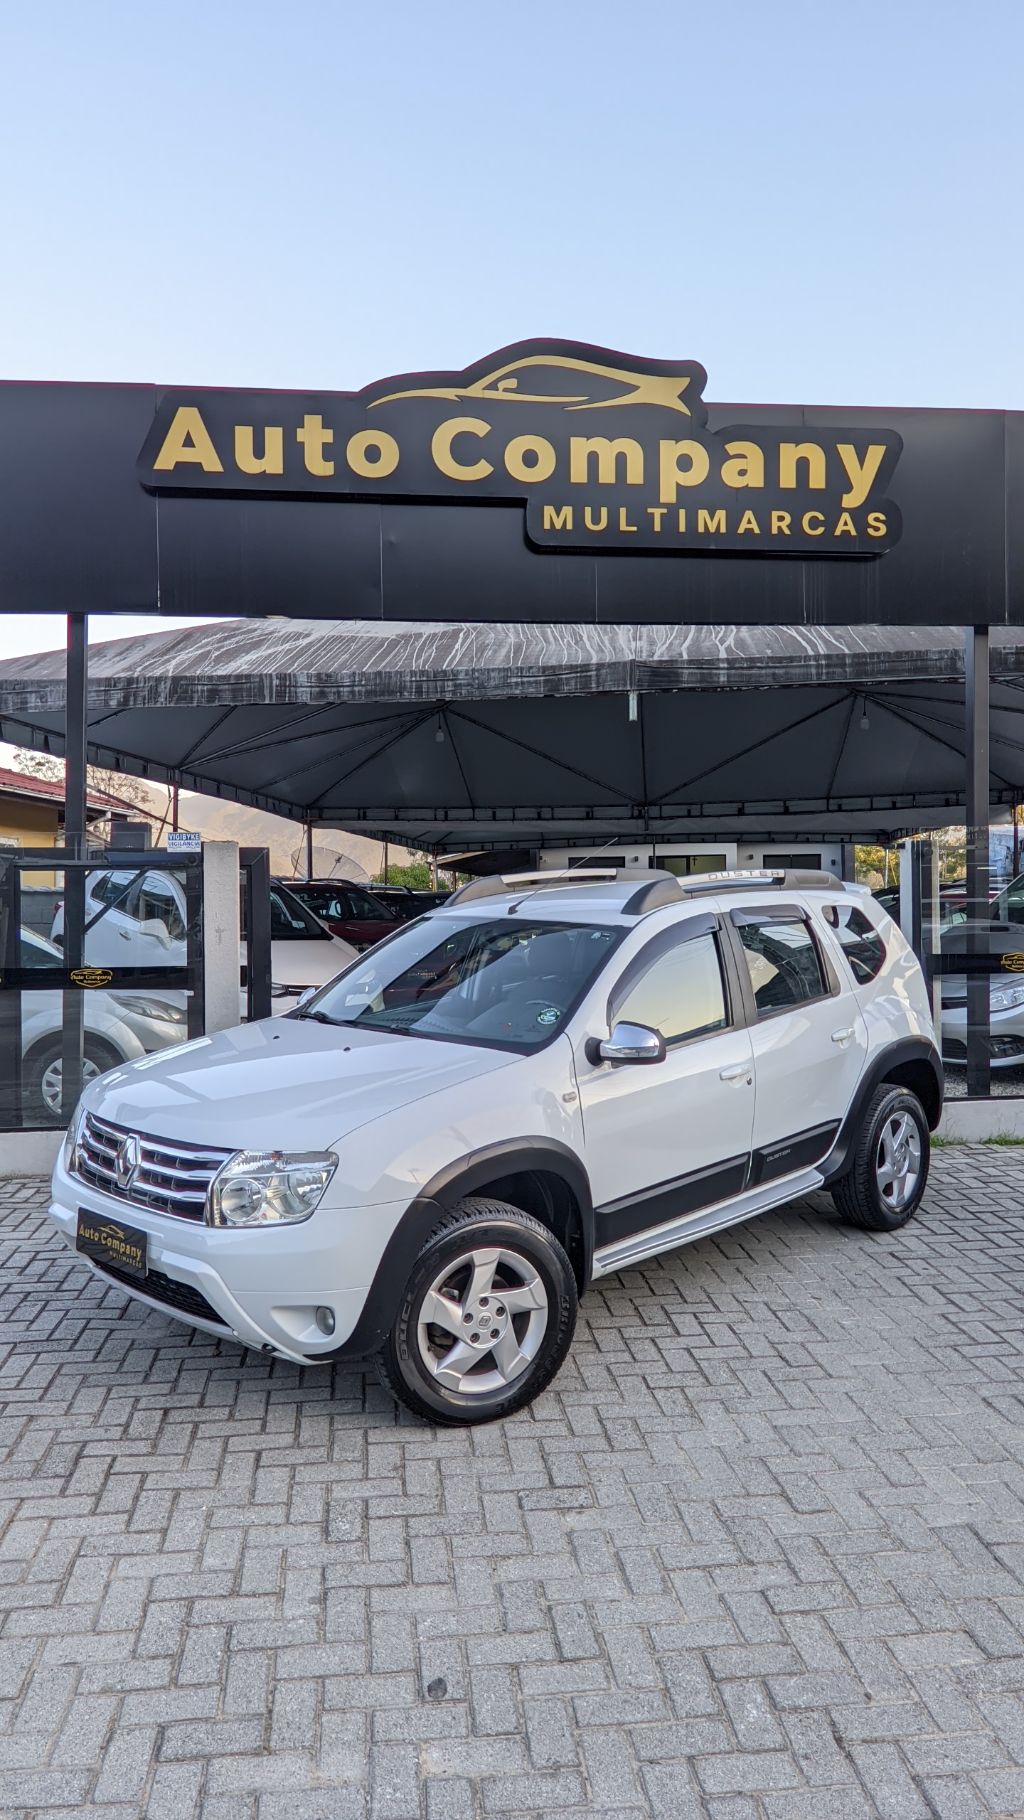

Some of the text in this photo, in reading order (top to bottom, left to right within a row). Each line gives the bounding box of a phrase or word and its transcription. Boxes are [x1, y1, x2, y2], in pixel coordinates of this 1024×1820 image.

[152, 406, 888, 509] Auto Company
[542, 505, 889, 538] MULTIMARCAS
[708, 871, 780, 880] DUSTER
[79, 1223, 142, 1261] Auto Company
